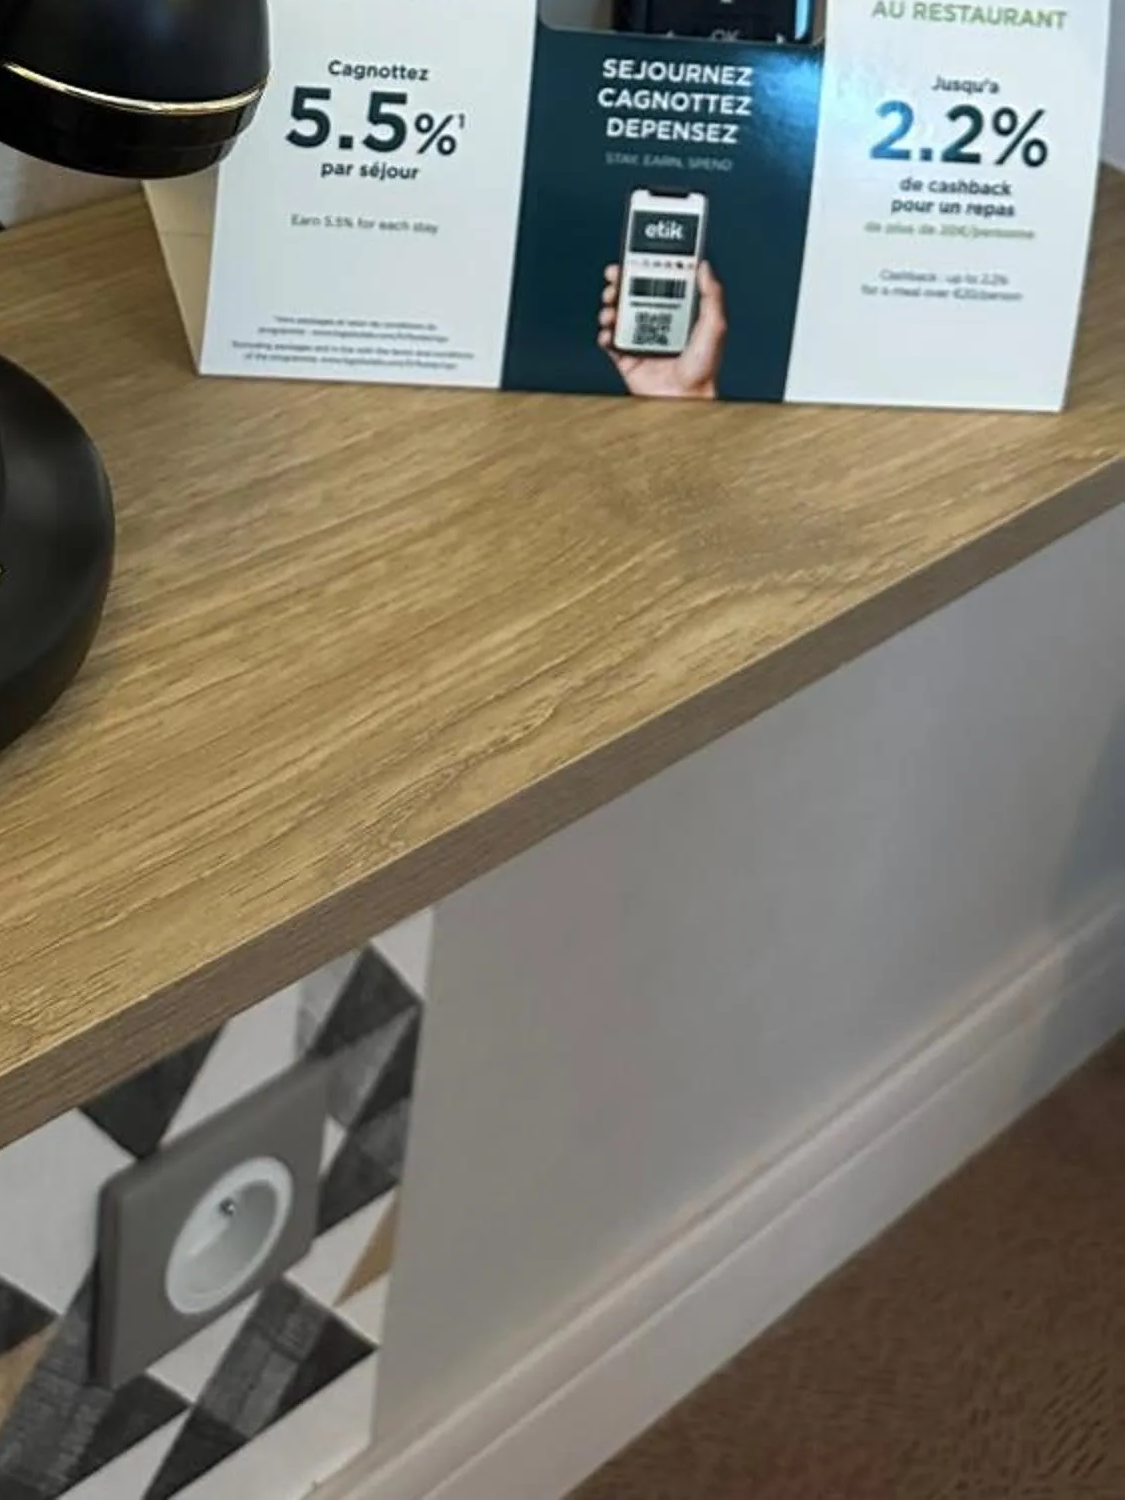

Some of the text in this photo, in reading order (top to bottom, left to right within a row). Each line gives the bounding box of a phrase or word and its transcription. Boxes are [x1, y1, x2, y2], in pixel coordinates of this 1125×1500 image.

[872, 0, 1067, 29] AU RESTAURANT
[328, 60, 430, 80] Cagnottez
[602, 58, 754, 87] SEJOURNEZ
[597, 87, 753, 116] CAGNOTTEZ
[606, 117, 739, 144] DEPENSEZ
[870, 100, 1049, 168] 2.2%
[321, 161, 420, 181] par séjour
[900, 177, 1013, 196] de cashback
[891, 199, 1015, 218] pour un repas
[645, 220, 683, 239] etik
